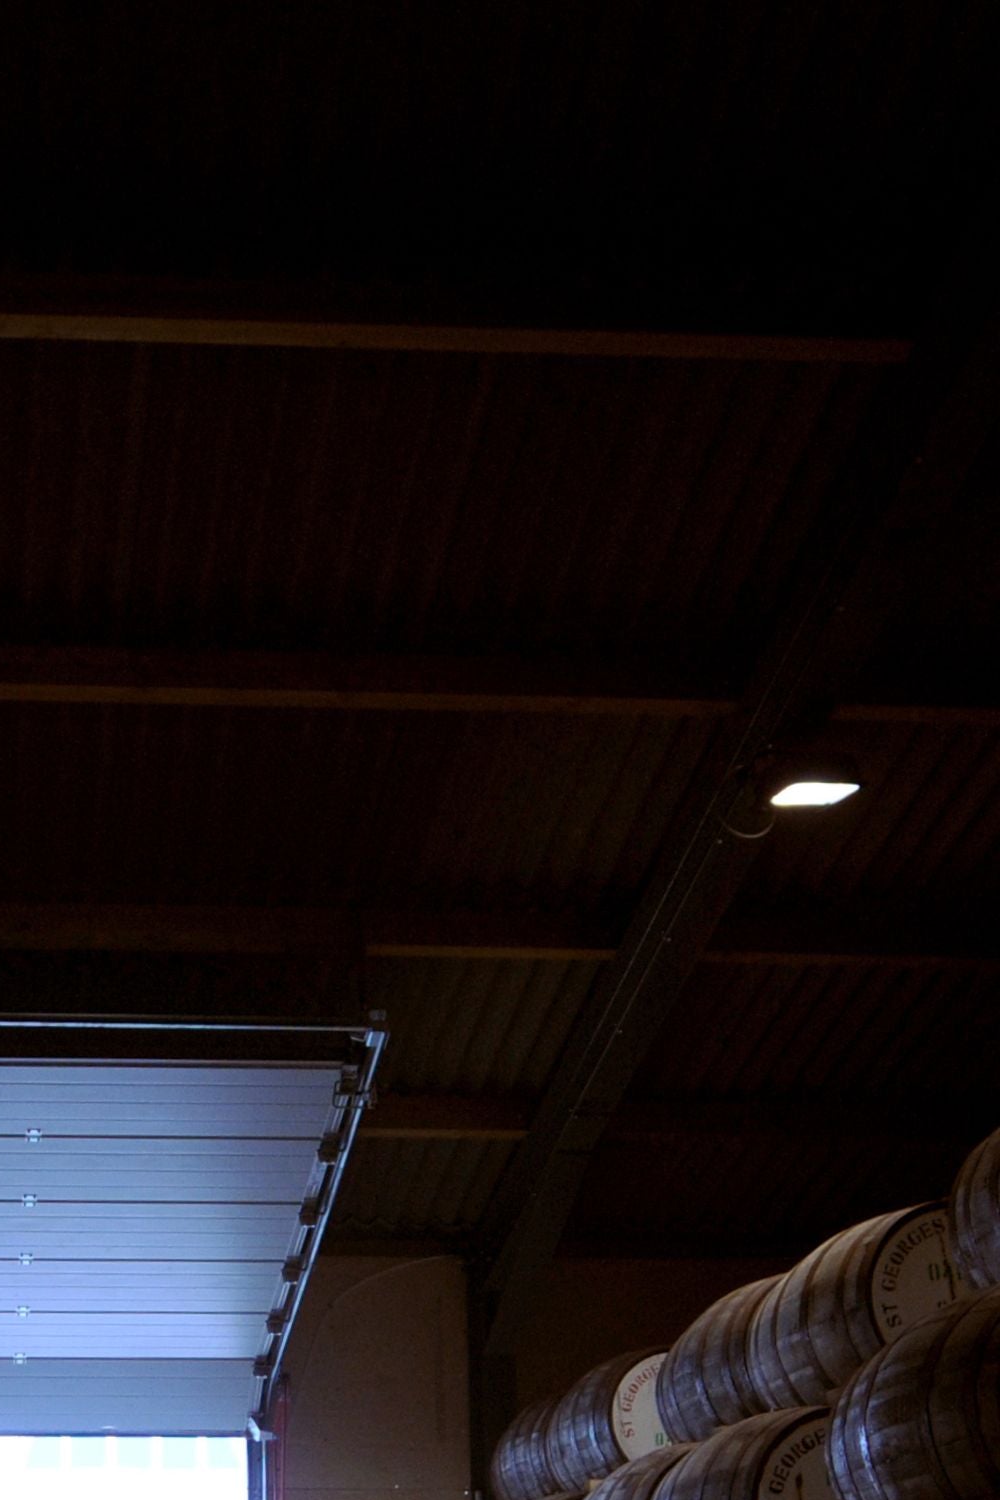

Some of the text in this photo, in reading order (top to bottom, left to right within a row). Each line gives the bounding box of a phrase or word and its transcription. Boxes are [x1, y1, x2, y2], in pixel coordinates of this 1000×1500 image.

[881, 1218, 946, 1292] GEORGES
[881, 1304, 902, 1328] ST
[622, 1363, 661, 1412] GEORGE
[769, 1427, 826, 1494] GEORGE
